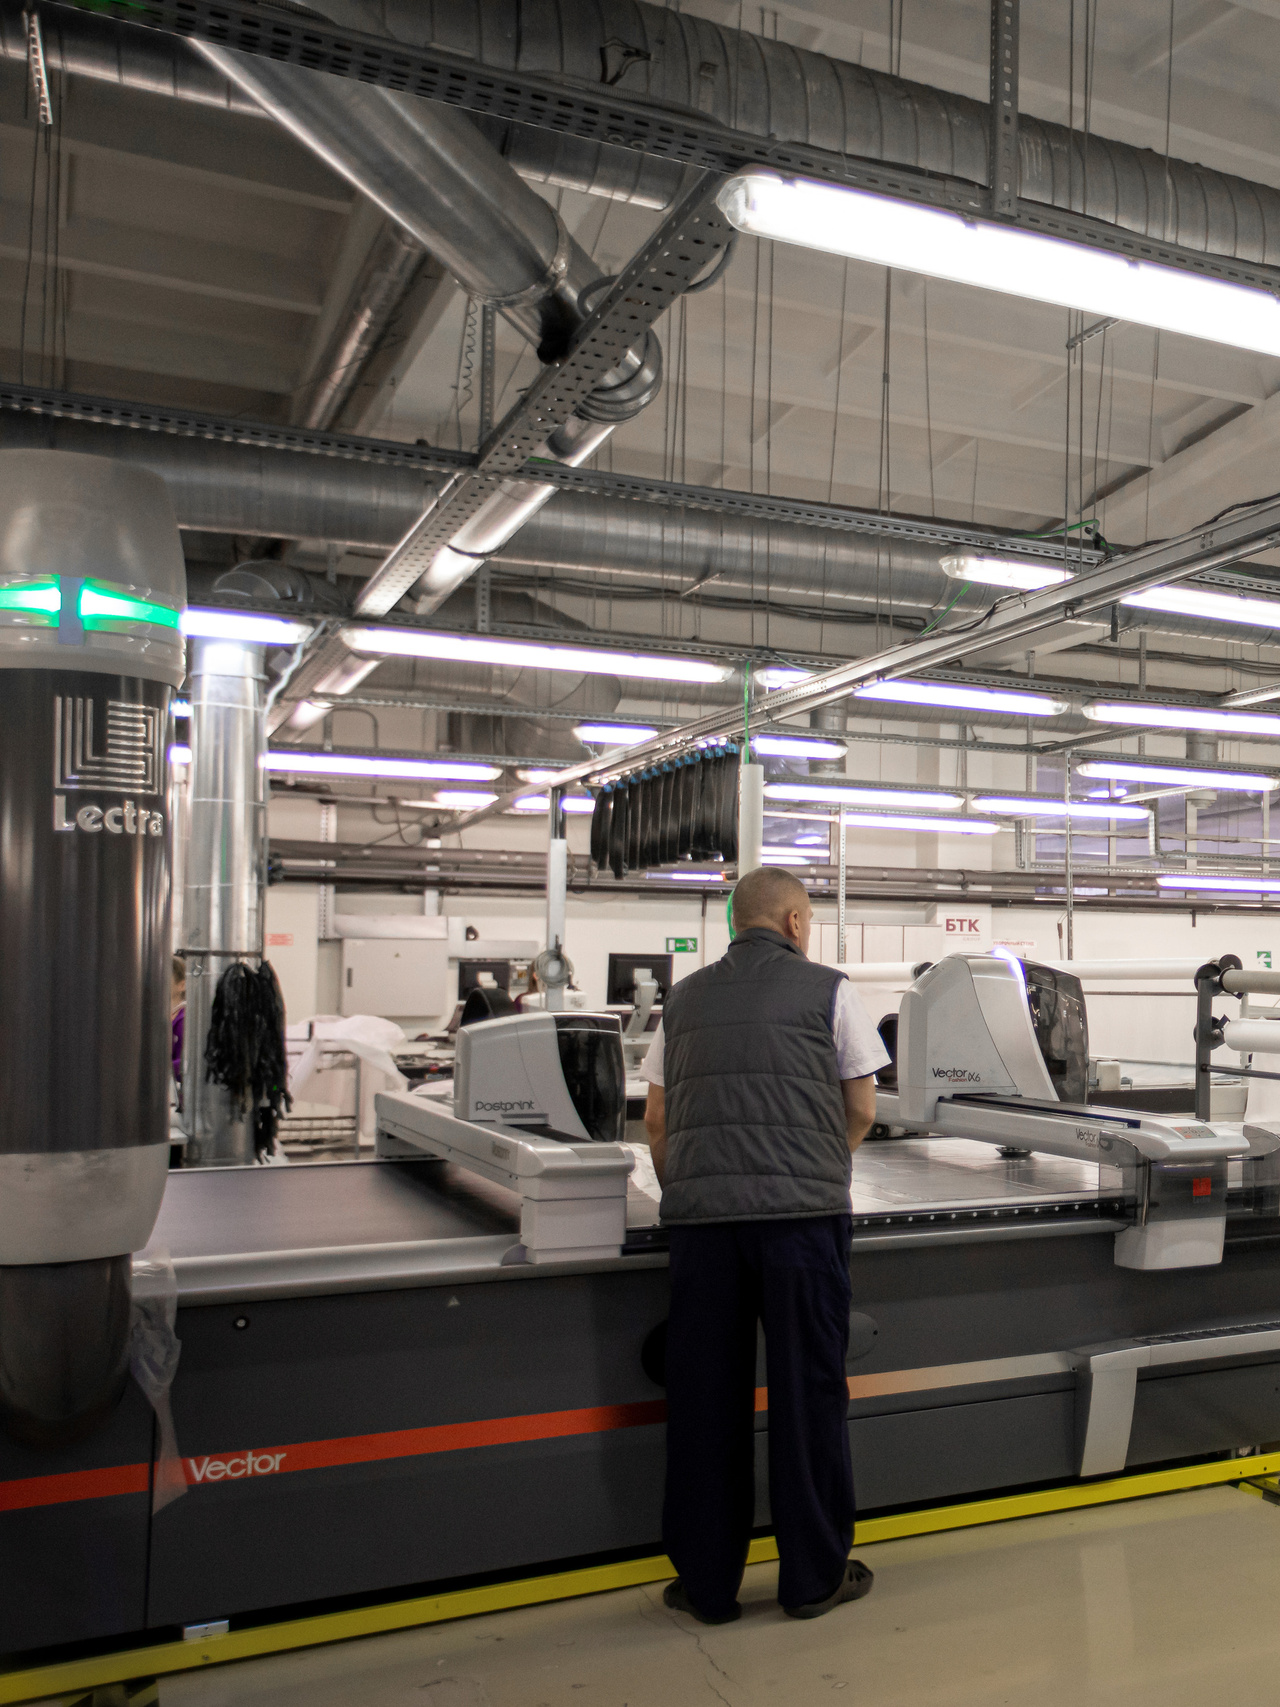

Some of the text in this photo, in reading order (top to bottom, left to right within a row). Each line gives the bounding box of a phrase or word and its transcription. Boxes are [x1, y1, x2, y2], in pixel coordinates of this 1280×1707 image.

[54, 795, 164, 836] Lectra
[945, 918, 980, 932] БТК
[932, 1067, 967, 1078] Vector
[475, 1100, 535, 1112] Postprint
[1075, 1127, 1097, 1143] Vector
[189, 1451, 287, 1482] Vector
